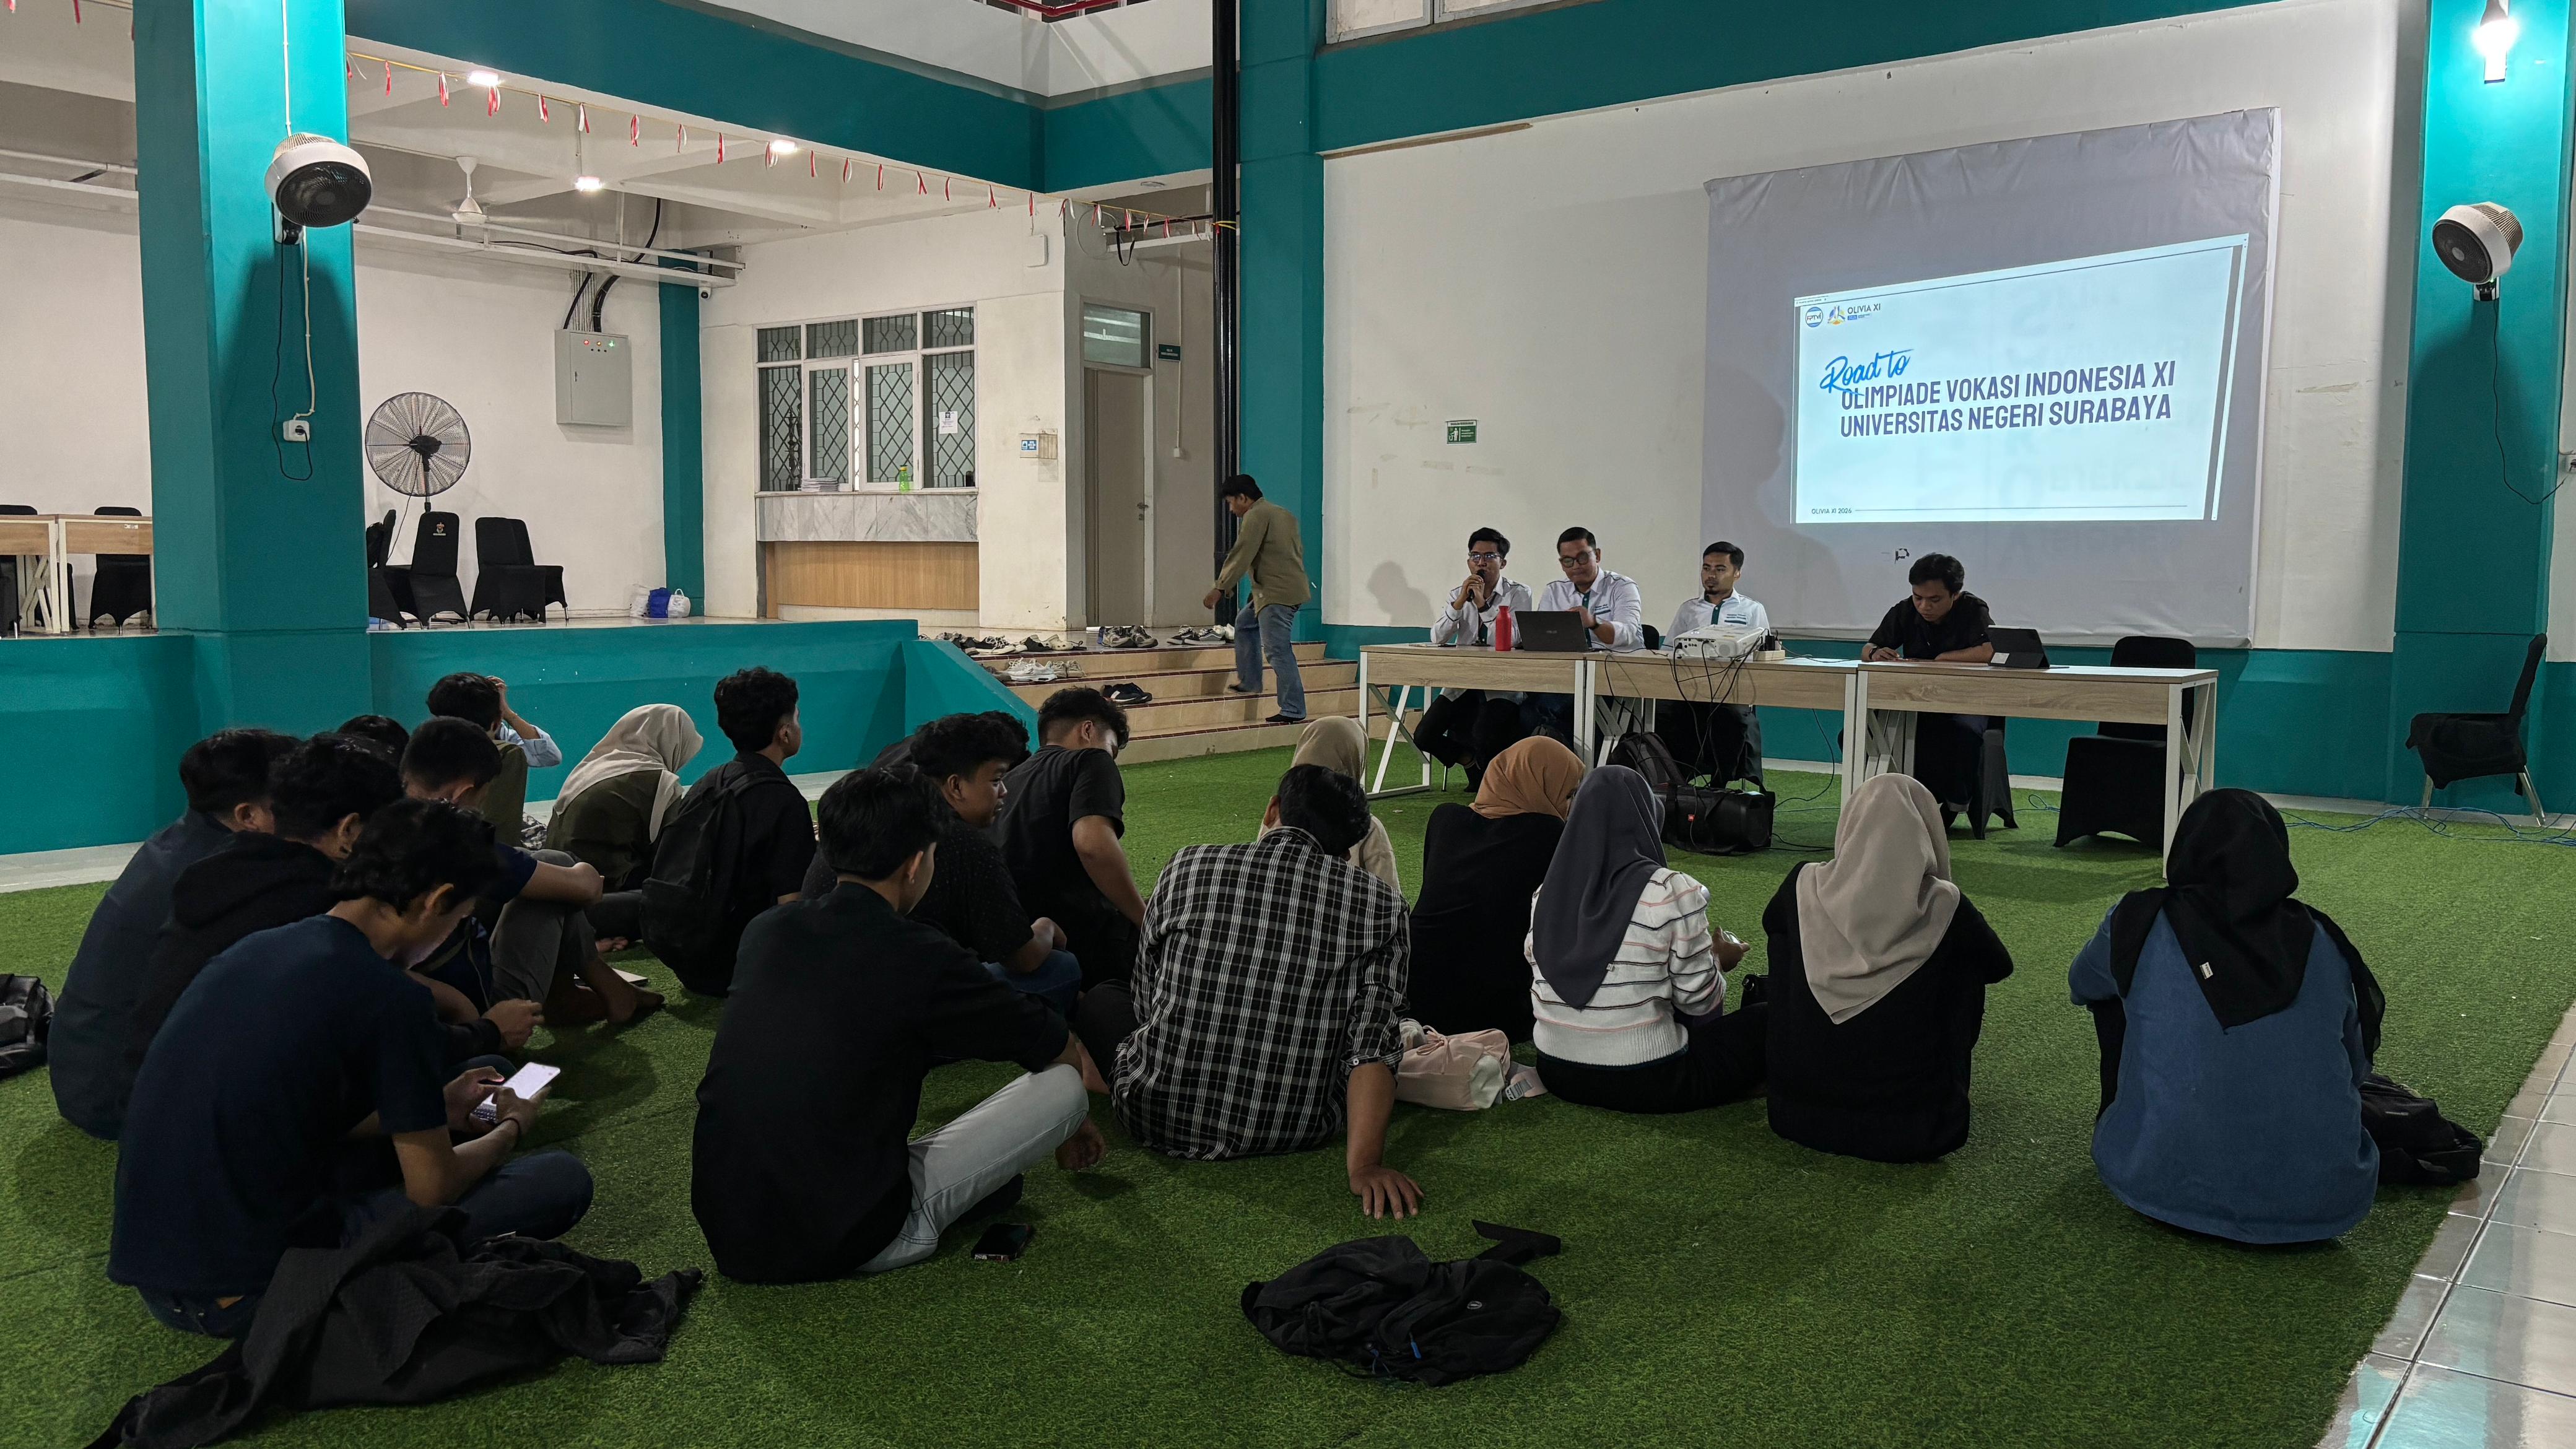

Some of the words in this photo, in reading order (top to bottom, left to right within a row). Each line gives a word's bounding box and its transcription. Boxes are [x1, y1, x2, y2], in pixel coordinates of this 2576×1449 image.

[1847, 305, 1871, 314] OLIVIA
[1873, 303, 1881, 311] XI
[1819, 352, 1881, 396] Road
[1879, 349, 1915, 378] to
[1842, 381, 1941, 410] OLIMPIADE
[1946, 375, 2020, 402] VOKASI
[2026, 363, 2146, 397] INDONESIA
[2152, 360, 2175, 388] XI
[1840, 408, 1963, 437] UNIVERSITAS
[1968, 402, 2043, 430] NEGERI
[2048, 394, 2171, 425] SURABAYA
